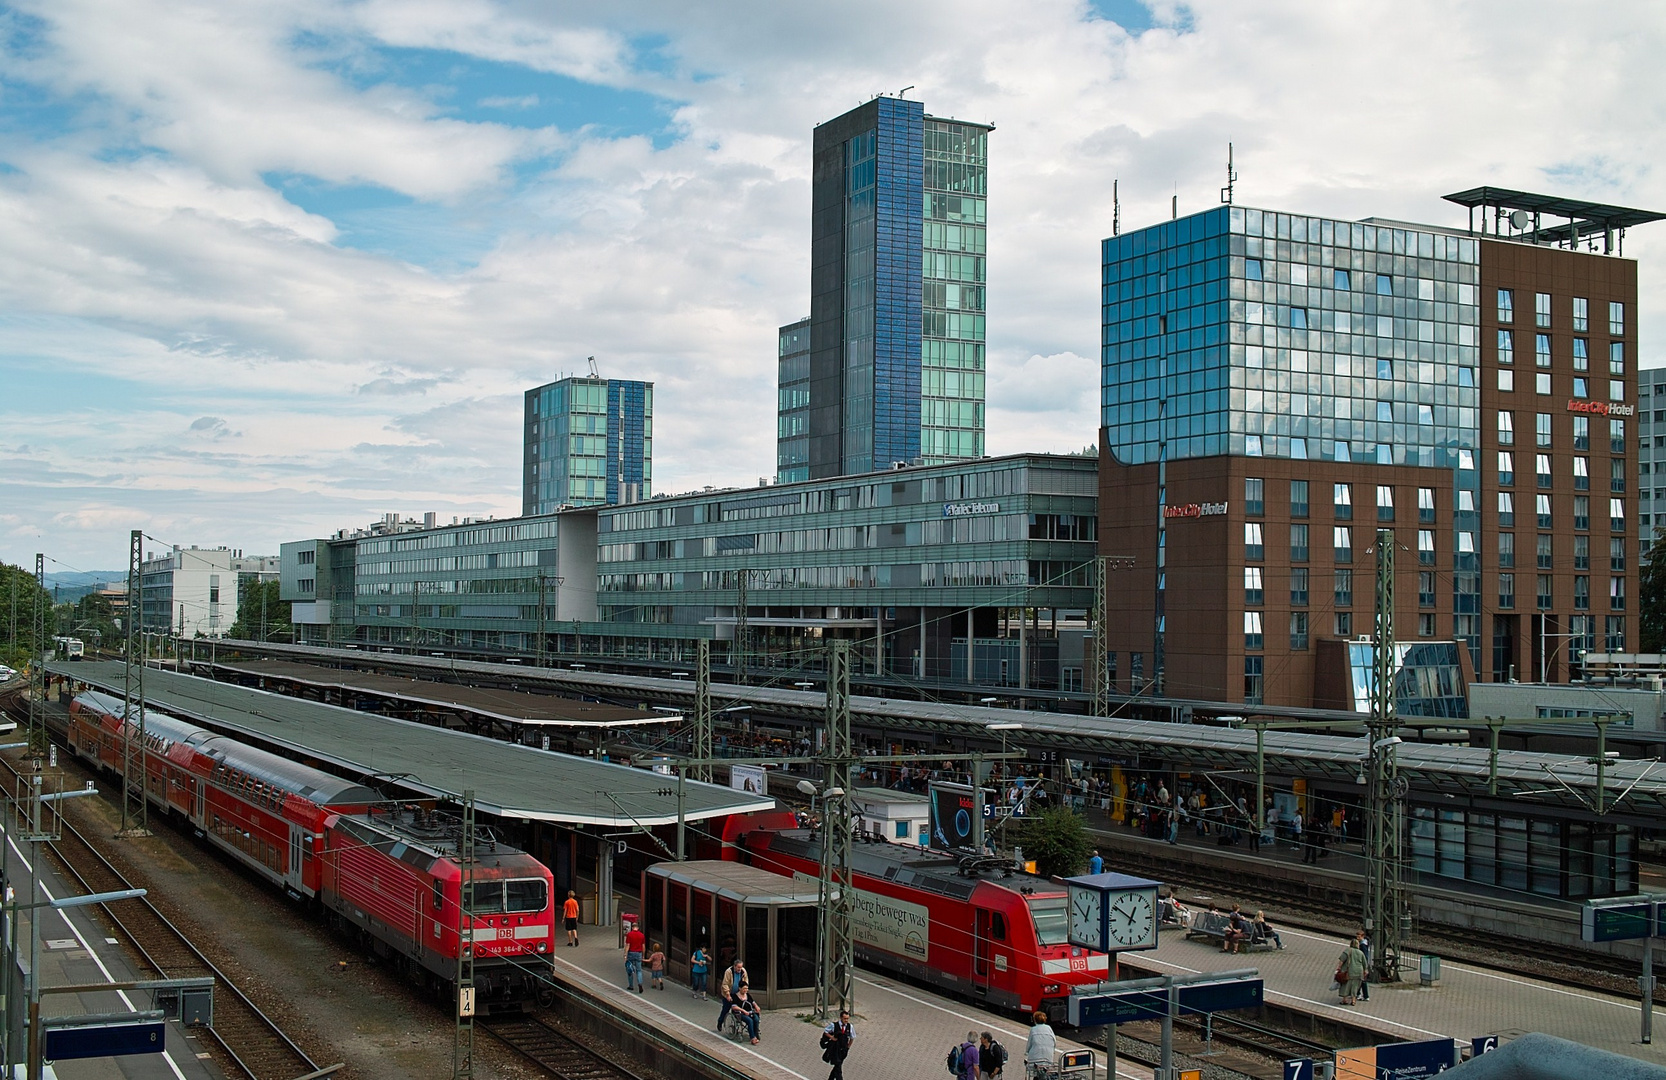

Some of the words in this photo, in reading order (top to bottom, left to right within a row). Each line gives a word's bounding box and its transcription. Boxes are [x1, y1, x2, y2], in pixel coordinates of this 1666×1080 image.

[1567, 399, 1634, 416] InterCityHotel
[1163, 501, 1228, 518] InterCityHotel
[1041, 751, 1047, 761] 3
[1050, 751, 1056, 760] E
[983, 804, 991, 816] 5
[1017, 804, 1025, 815] 4
[617, 840, 627, 853] D
[875, 897, 908, 927] bewegt
[909, 912, 926, 928] was
[499, 928, 513, 938] DB
[1073, 959, 1085, 970] DB
[464, 989, 470, 1000] 1
[1251, 987, 1257, 997] 6
[463, 1001, 471, 1012] 4
[1084, 1006, 1090, 1015] 7
[150, 1032, 157, 1042] 8
[1484, 1037, 1495, 1054] 6
[1289, 1061, 1303, 1080] 7
